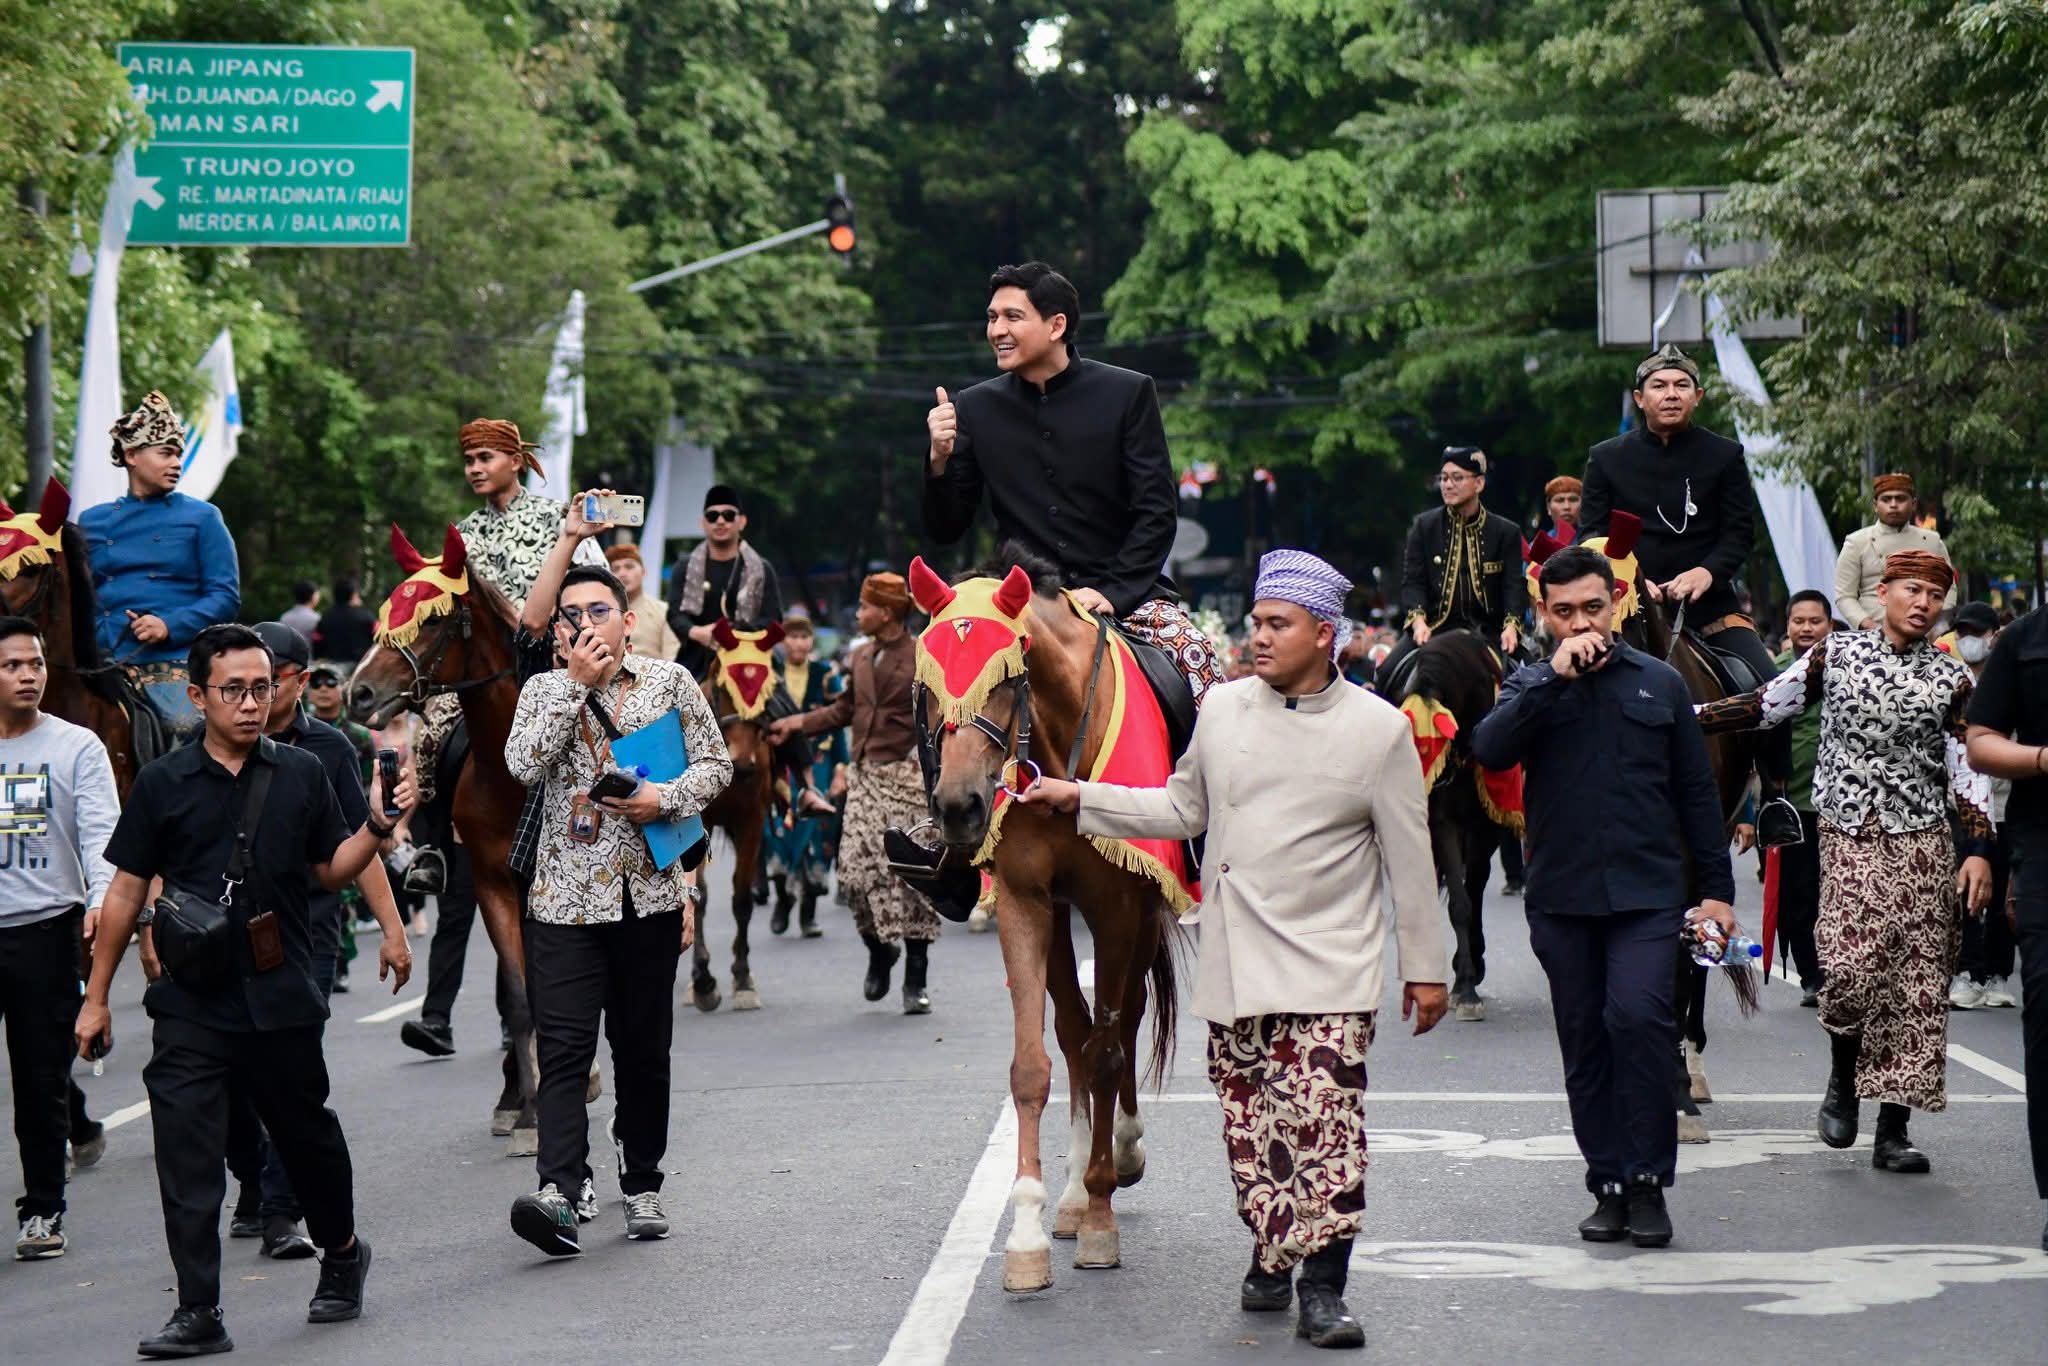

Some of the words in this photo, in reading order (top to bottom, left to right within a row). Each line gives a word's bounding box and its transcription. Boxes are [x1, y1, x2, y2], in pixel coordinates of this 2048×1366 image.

[127, 56, 195, 76] ARIA
[204, 58, 305, 78] JIPANG
[160, 113, 225, 133] MAN
[231, 114, 299, 134] SARI
[181, 157, 356, 177] TRUNOJOYO
